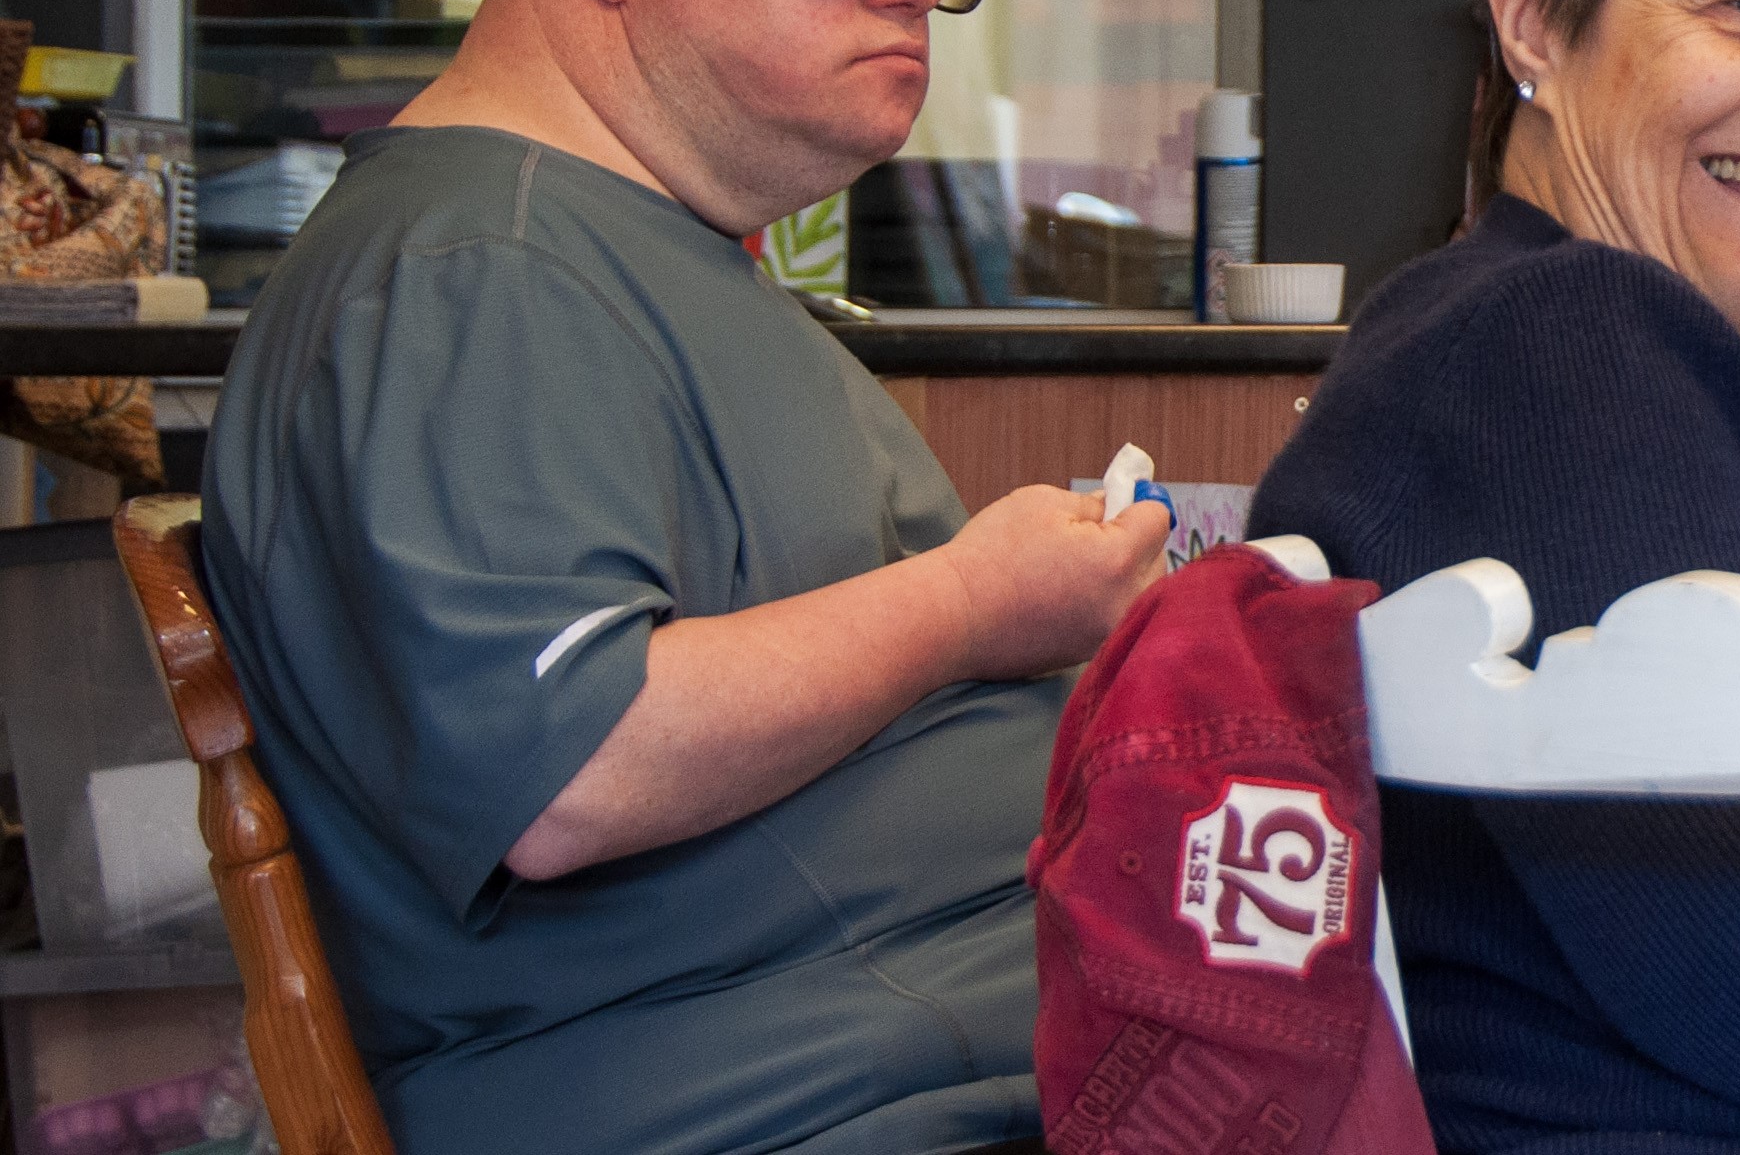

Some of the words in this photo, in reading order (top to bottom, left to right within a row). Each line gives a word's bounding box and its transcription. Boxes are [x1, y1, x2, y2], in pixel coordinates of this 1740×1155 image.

[1185, 834, 1212, 907] EST.
[1211, 803, 1325, 945] 75
[1323, 837, 1349, 935] ORIGINAL
